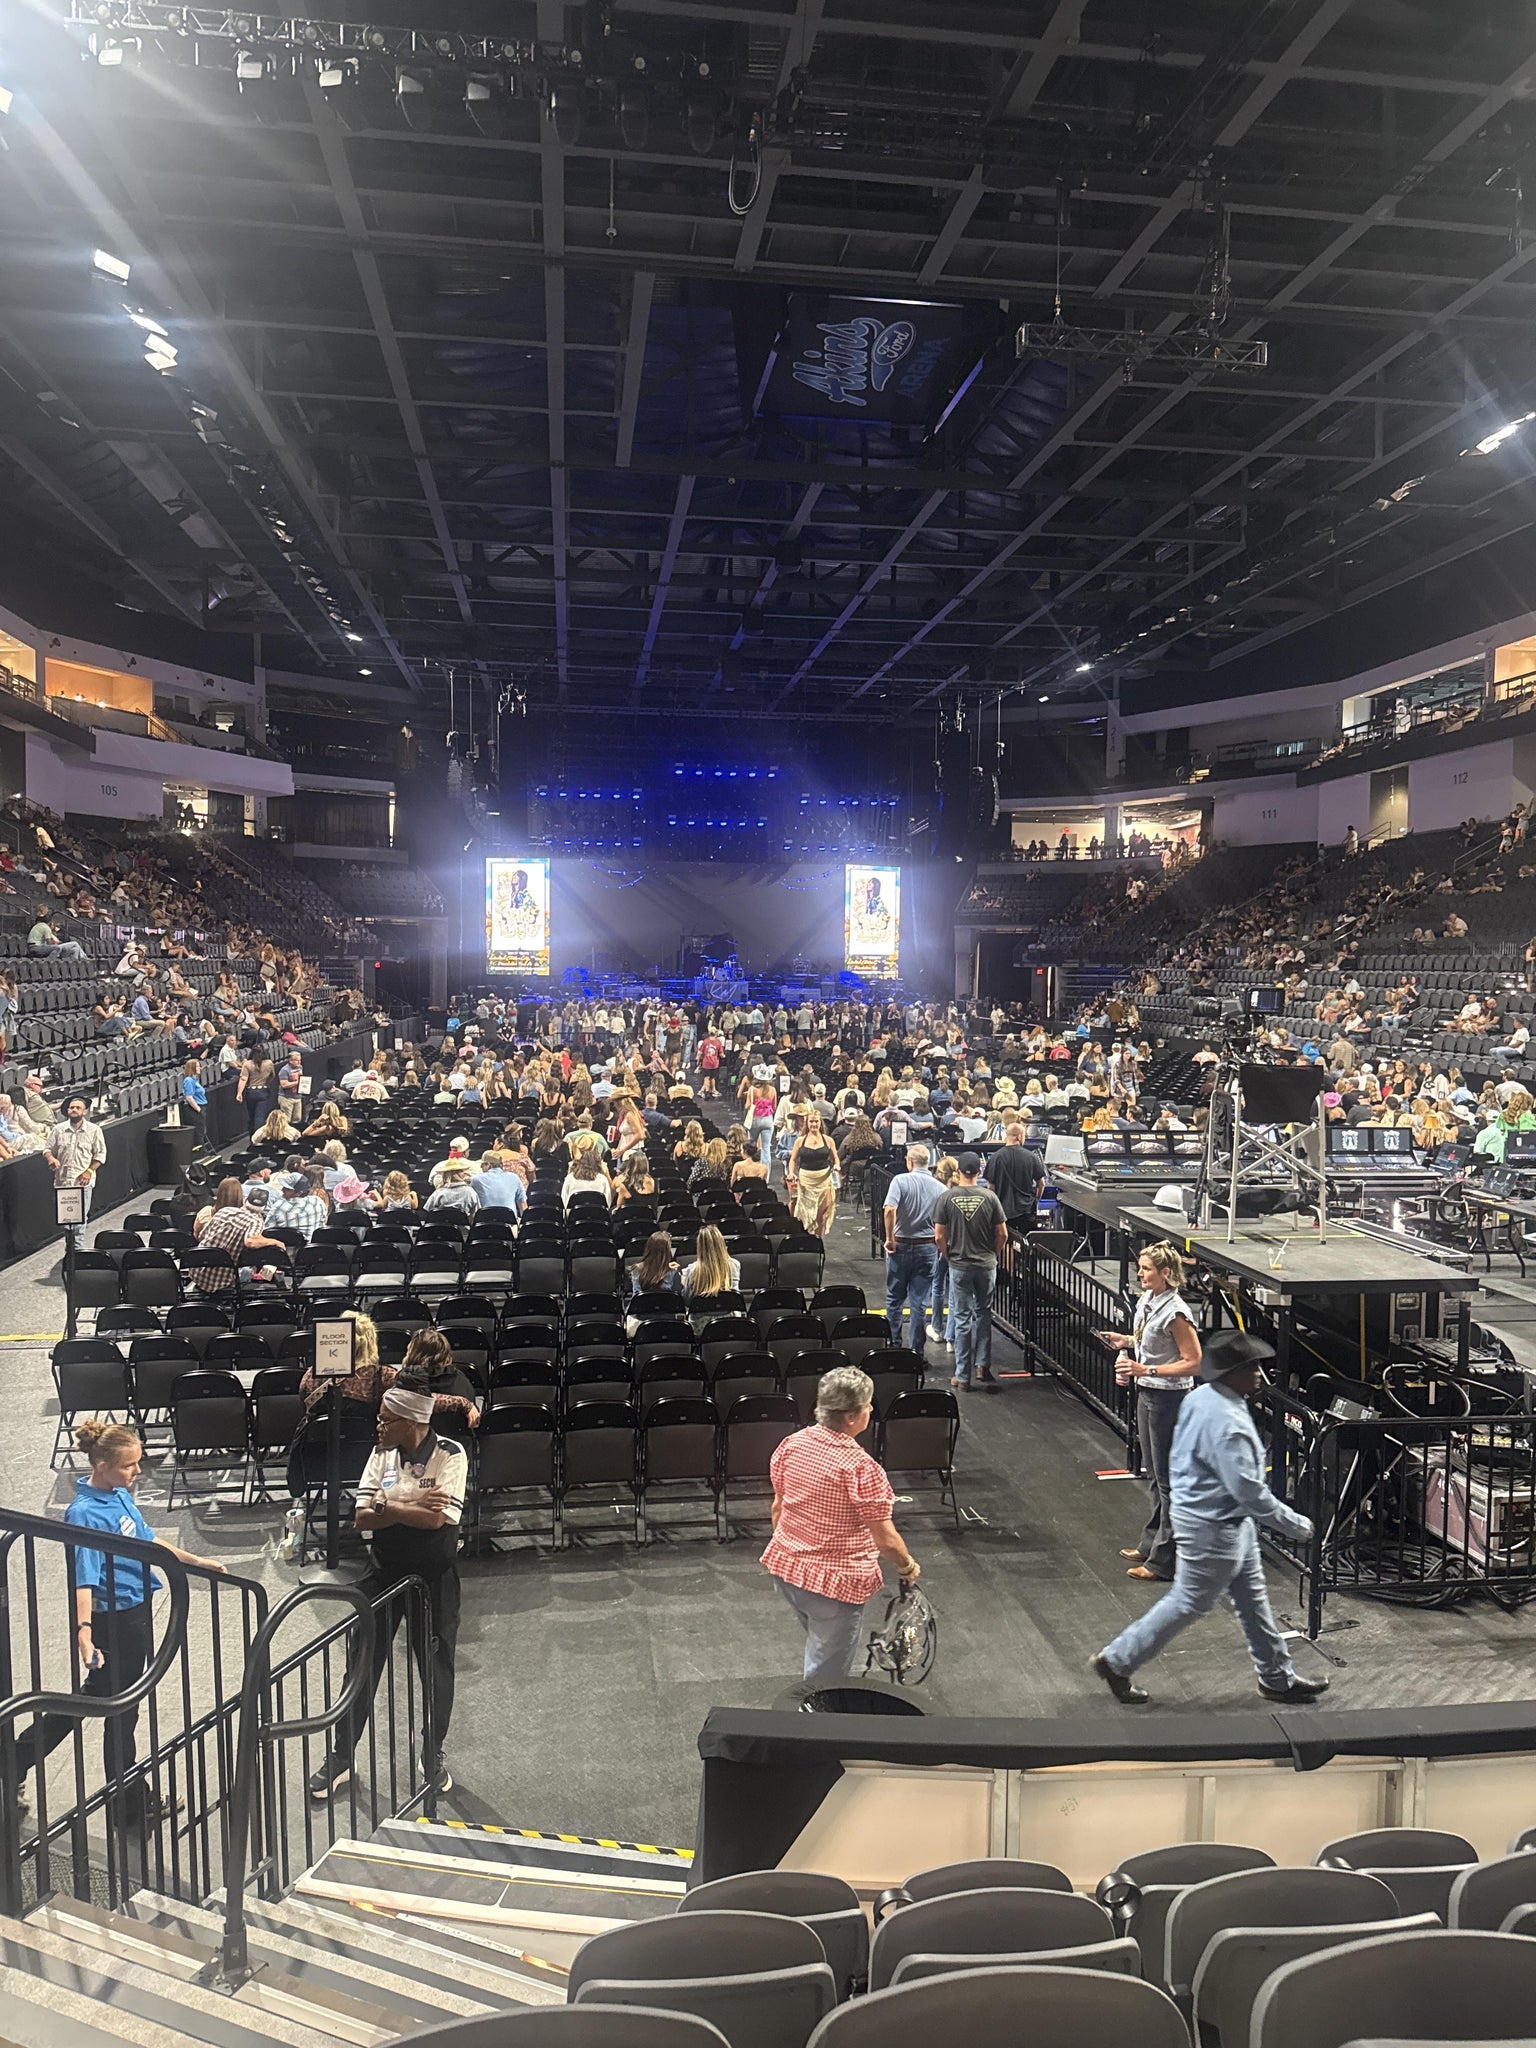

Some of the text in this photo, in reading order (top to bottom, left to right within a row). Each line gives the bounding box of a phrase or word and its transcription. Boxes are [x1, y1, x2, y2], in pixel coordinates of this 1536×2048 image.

[793, 317, 886, 407] Akins
[896, 336, 951, 399] ARENA
[1453, 771, 1468, 785] 112
[100, 784, 118, 797] 105
[1262, 809, 1277, 819] 111
[329, 1348, 338, 1358] K
